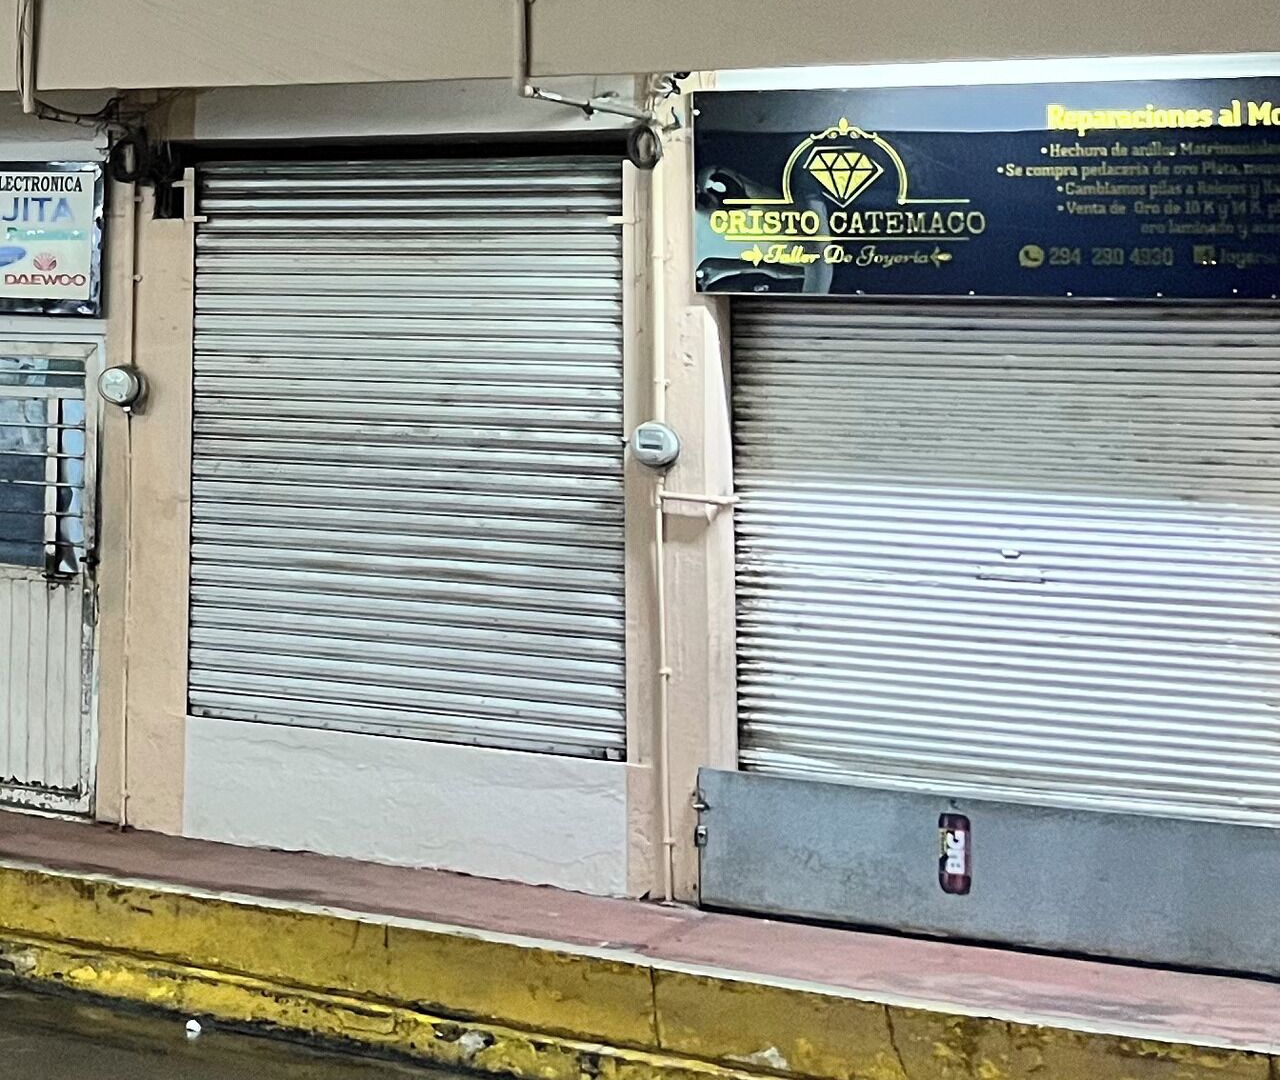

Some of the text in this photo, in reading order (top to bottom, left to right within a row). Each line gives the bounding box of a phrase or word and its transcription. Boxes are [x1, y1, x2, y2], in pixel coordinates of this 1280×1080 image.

[1047, 104, 1213, 137] Reparaciones
[1218, 99, 1241, 127] al
[1049, 141, 1108, 158] Hechura
[1111, 140, 1128, 157] de
[1005, 163, 1022, 177] Se
[1025, 166, 1077, 181] compra
[1065, 180, 1147, 196] Cambiamos
[1066, 200, 1105, 215] Venta
[1110, 200, 1126, 214] de
[1164, 200, 1181, 214] de
[709, 210, 986, 235] CRISTO CATEMACO
[762, 245, 820, 264] Taller
[824, 244, 852, 264] De
[1049, 247, 1081, 265] 294
[4, 274, 87, 286] DAEWOO
